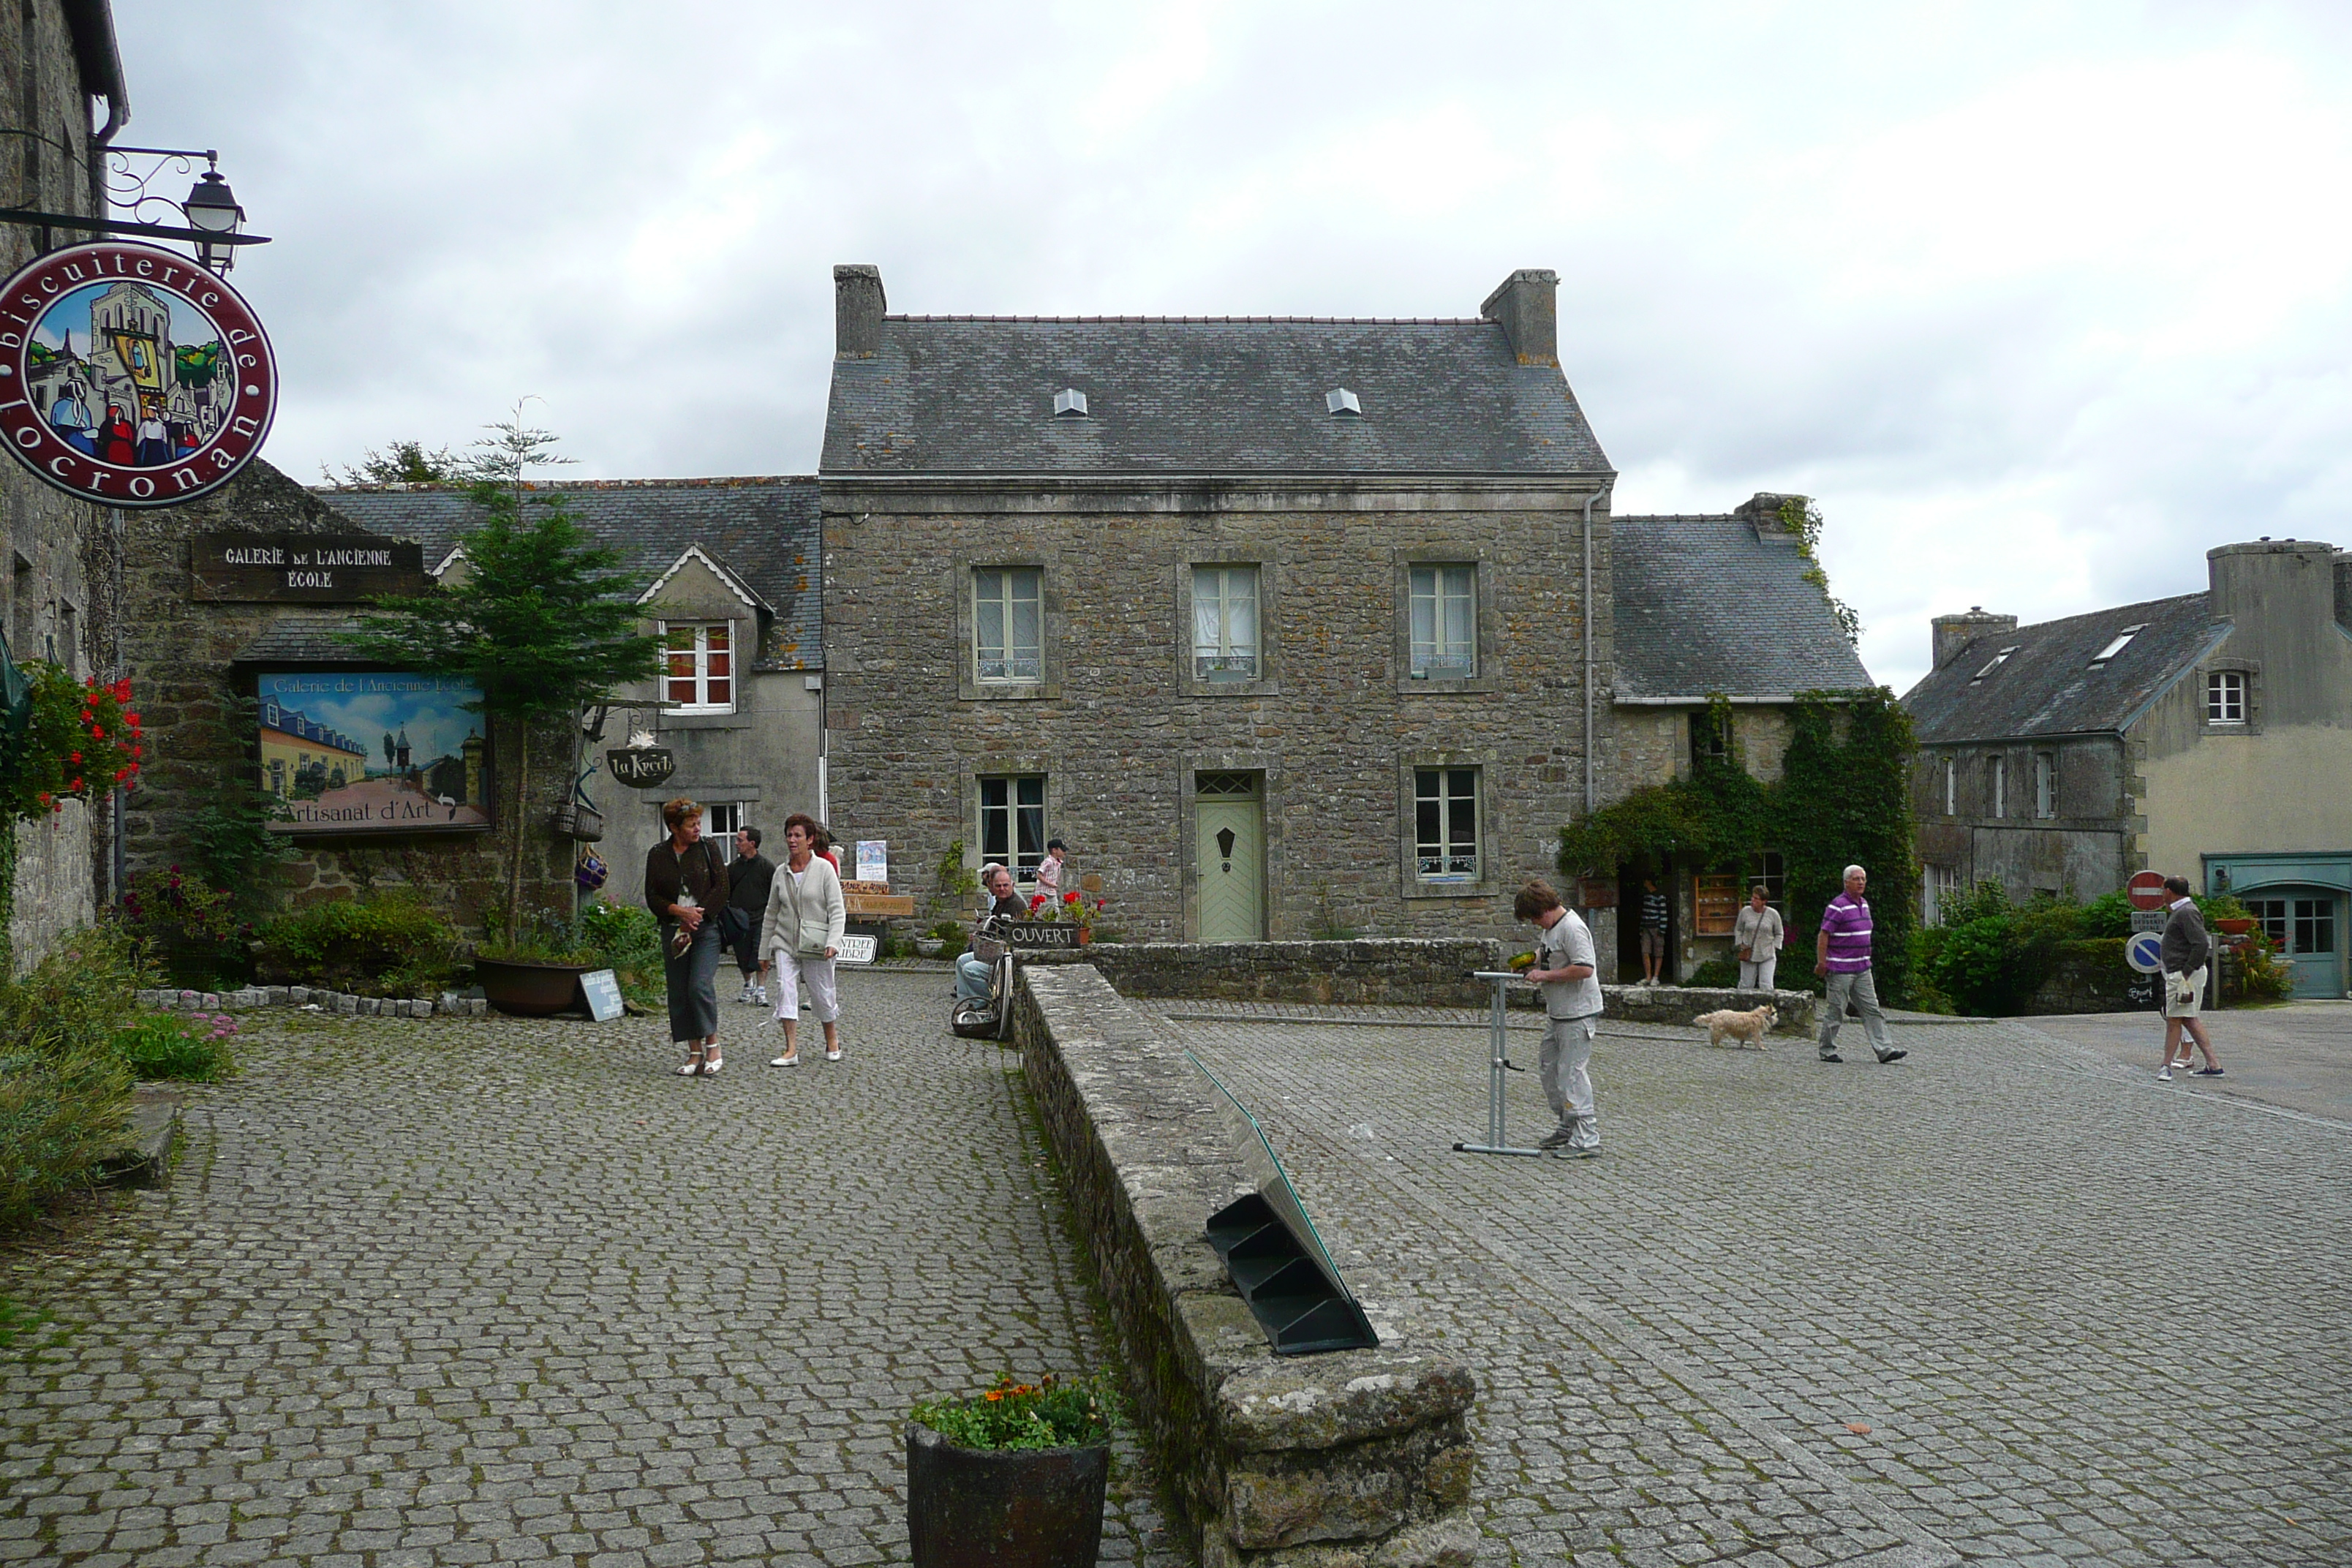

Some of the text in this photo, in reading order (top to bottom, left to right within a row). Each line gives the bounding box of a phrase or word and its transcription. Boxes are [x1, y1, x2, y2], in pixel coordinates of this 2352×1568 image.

[0, 251, 257, 369] biscuiterie de
[225, 546, 285, 565] GALERIE
[317, 548, 392, 566] L'ANCIENNE
[274, 679, 329, 693] Galerie
[335, 679, 355, 693] de
[380, 799, 434, 820] d'Art
[840, 938, 872, 949] NTREE
[1011, 927, 1074, 943] OUVERT
